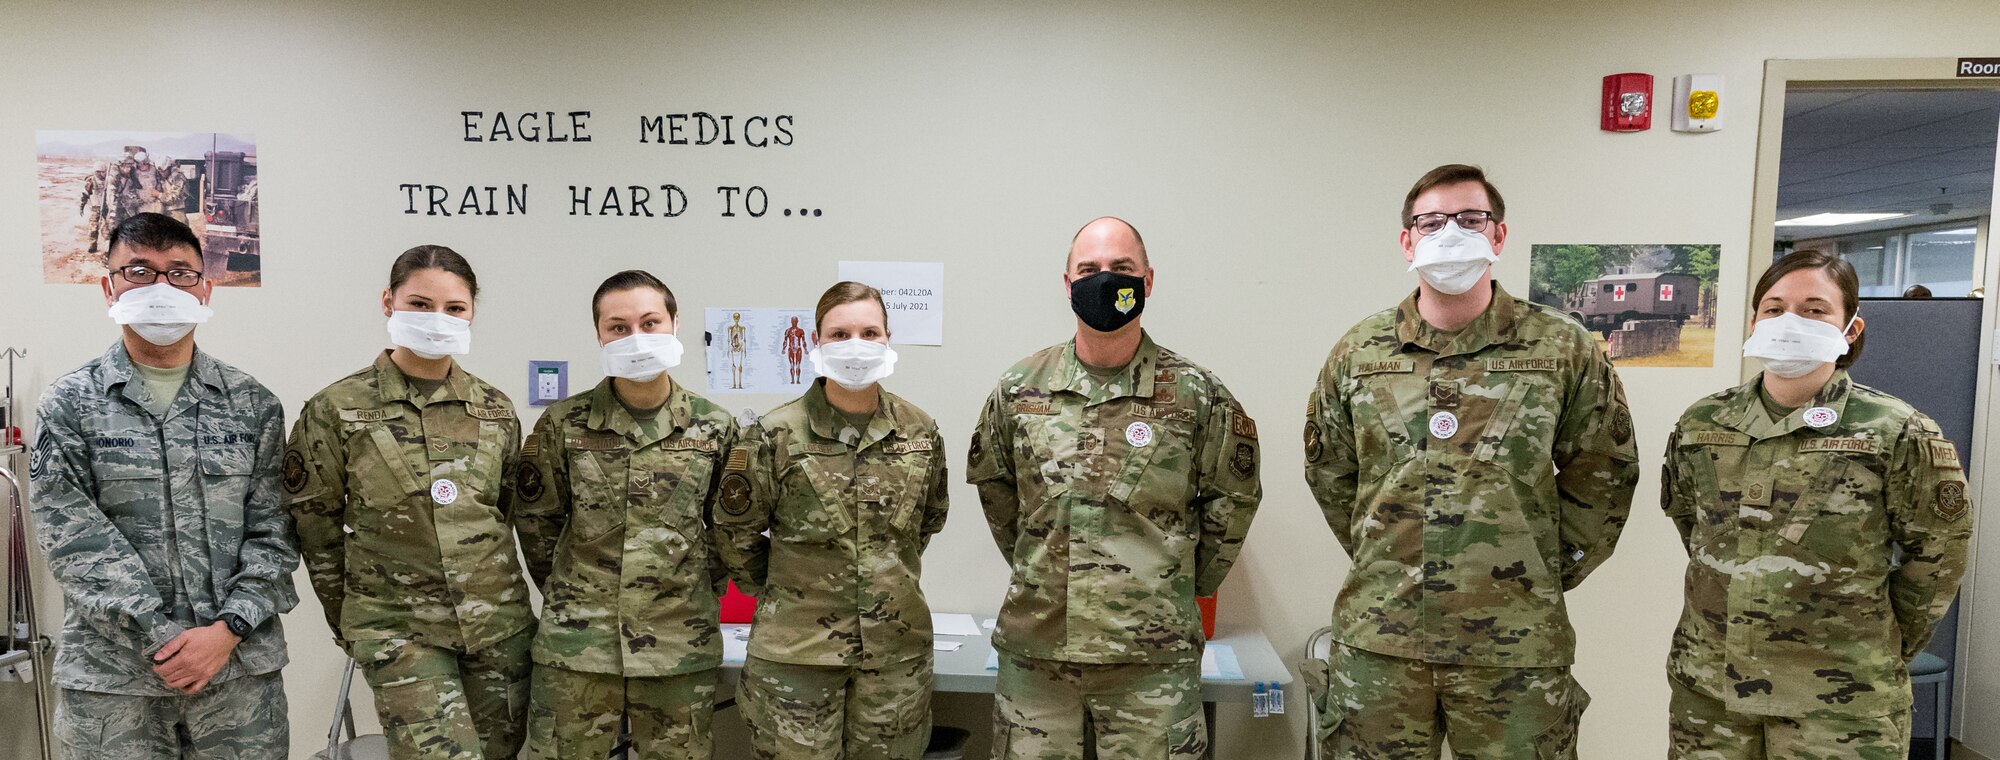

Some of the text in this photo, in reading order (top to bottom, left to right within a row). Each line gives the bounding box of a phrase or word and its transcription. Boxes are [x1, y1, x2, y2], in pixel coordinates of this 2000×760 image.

[461, 111, 794, 147] EAGLE MEDICS
[400, 183, 528, 216] TRAIN
[569, 184, 688, 217] HARD
[880, 288, 932, 297] ber: 042L20A
[893, 302, 908, 311] July
[1358, 361, 1401, 372] HALLMAN
[1509, 360, 1524, 369] AIR
[1526, 359, 1555, 369] FORCE
[487, 409, 512, 418] FORCE
[1016, 403, 1051, 414] GRISHAM
[357, 410, 387, 420] RENDA
[224, 434, 237, 444] AIR
[1697, 432, 1736, 443] HARRIS
[908, 440, 930, 451] FORCE
[1821, 439, 1839, 449] AIR
[1841, 439, 1876, 452] FORCE
[1933, 446, 1957, 461] MED
